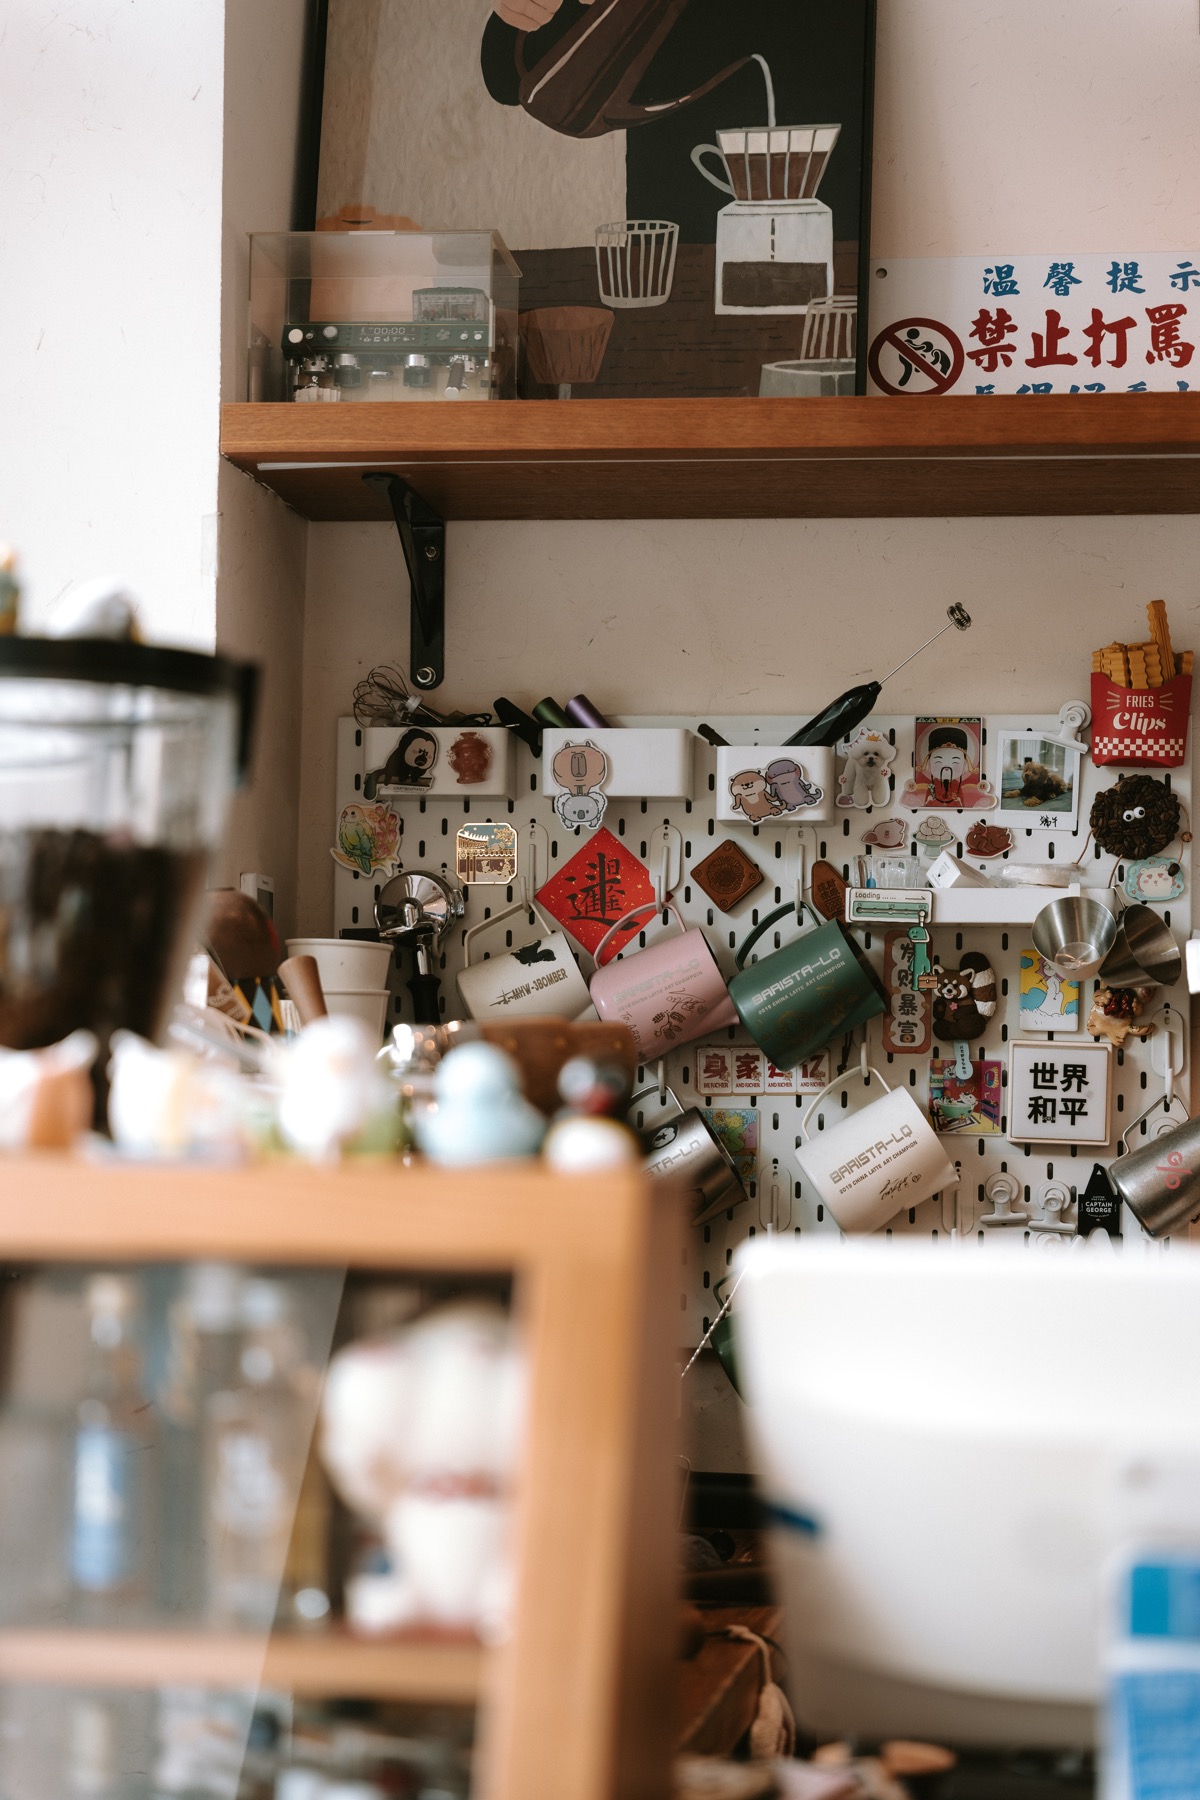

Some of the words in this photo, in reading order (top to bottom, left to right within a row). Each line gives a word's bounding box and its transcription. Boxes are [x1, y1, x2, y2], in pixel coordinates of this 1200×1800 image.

[966, 304, 1195, 372] 禁止打罵
[1126, 695, 1154, 708] FRIES
[1112, 711, 1167, 736] Clips
[855, 891, 881, 900] Loading
[511, 967, 568, 1000] MHW-3BOMBER
[751, 947, 841, 1006] BARISTA-LQ
[772, 995, 789, 1007] CHINA
[789, 986, 805, 997] LATTE
[805, 978, 816, 986] ART
[816, 960, 846, 980] CHAMPION
[1029, 1062, 1089, 1093] 世界
[1027, 1095, 1088, 1126] 和平
[829, 1123, 913, 1184] BARISTA-LQ
[852, 1173, 868, 1186] CHINA
[868, 1164, 883, 1176] LATTE
[882, 1156, 893, 1167] ART
[892, 1140, 918, 1159] CHAMPION
